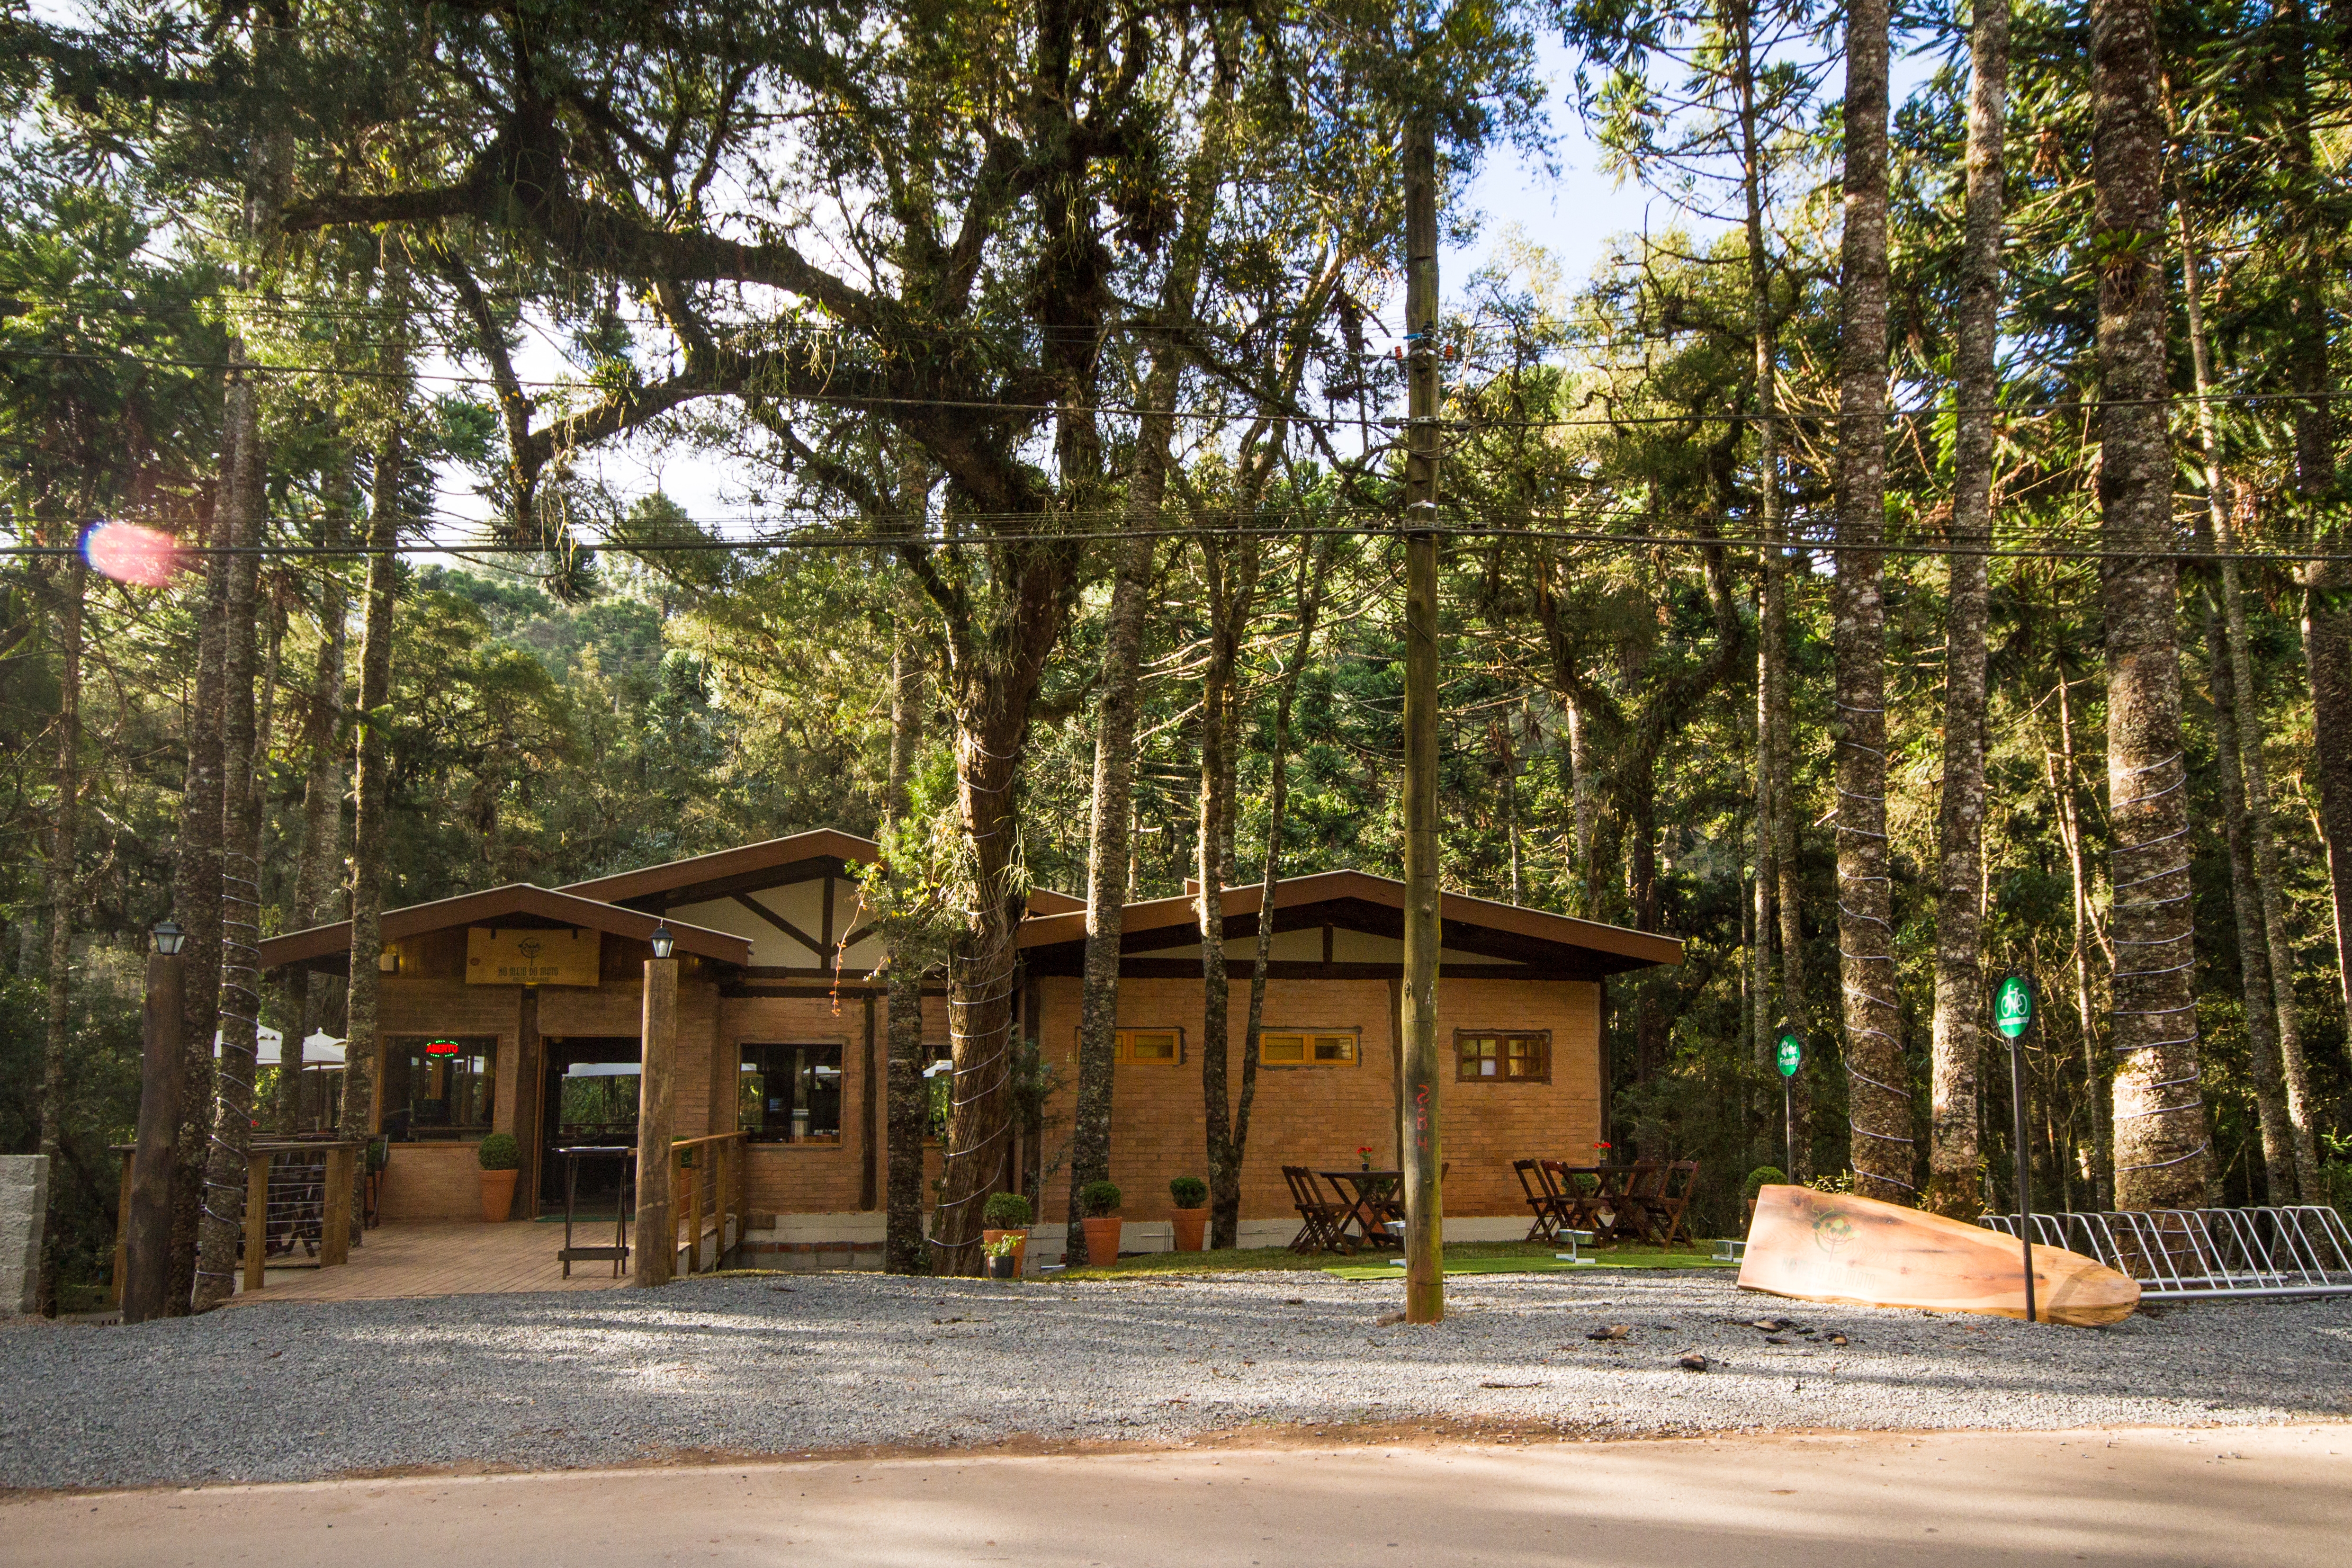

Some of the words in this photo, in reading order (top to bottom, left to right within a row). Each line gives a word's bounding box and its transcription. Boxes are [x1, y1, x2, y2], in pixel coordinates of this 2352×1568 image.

[498, 967, 507, 976] NO
[509, 967, 527, 976] MEIO
[529, 967, 538, 976] DO
[540, 967, 558, 976] MATO
[426, 1044, 458, 1053] ABERTO
[1788, 1045, 1797, 1055] Pet
[1779, 1055, 1799, 1066] Friendly
[1781, 1257, 1795, 1273] NO
[1828, 1266, 1842, 1282] DO
[1845, 1269, 1876, 1290] MATO
[1804, 1281, 1843, 1293] RESTAURANTE
